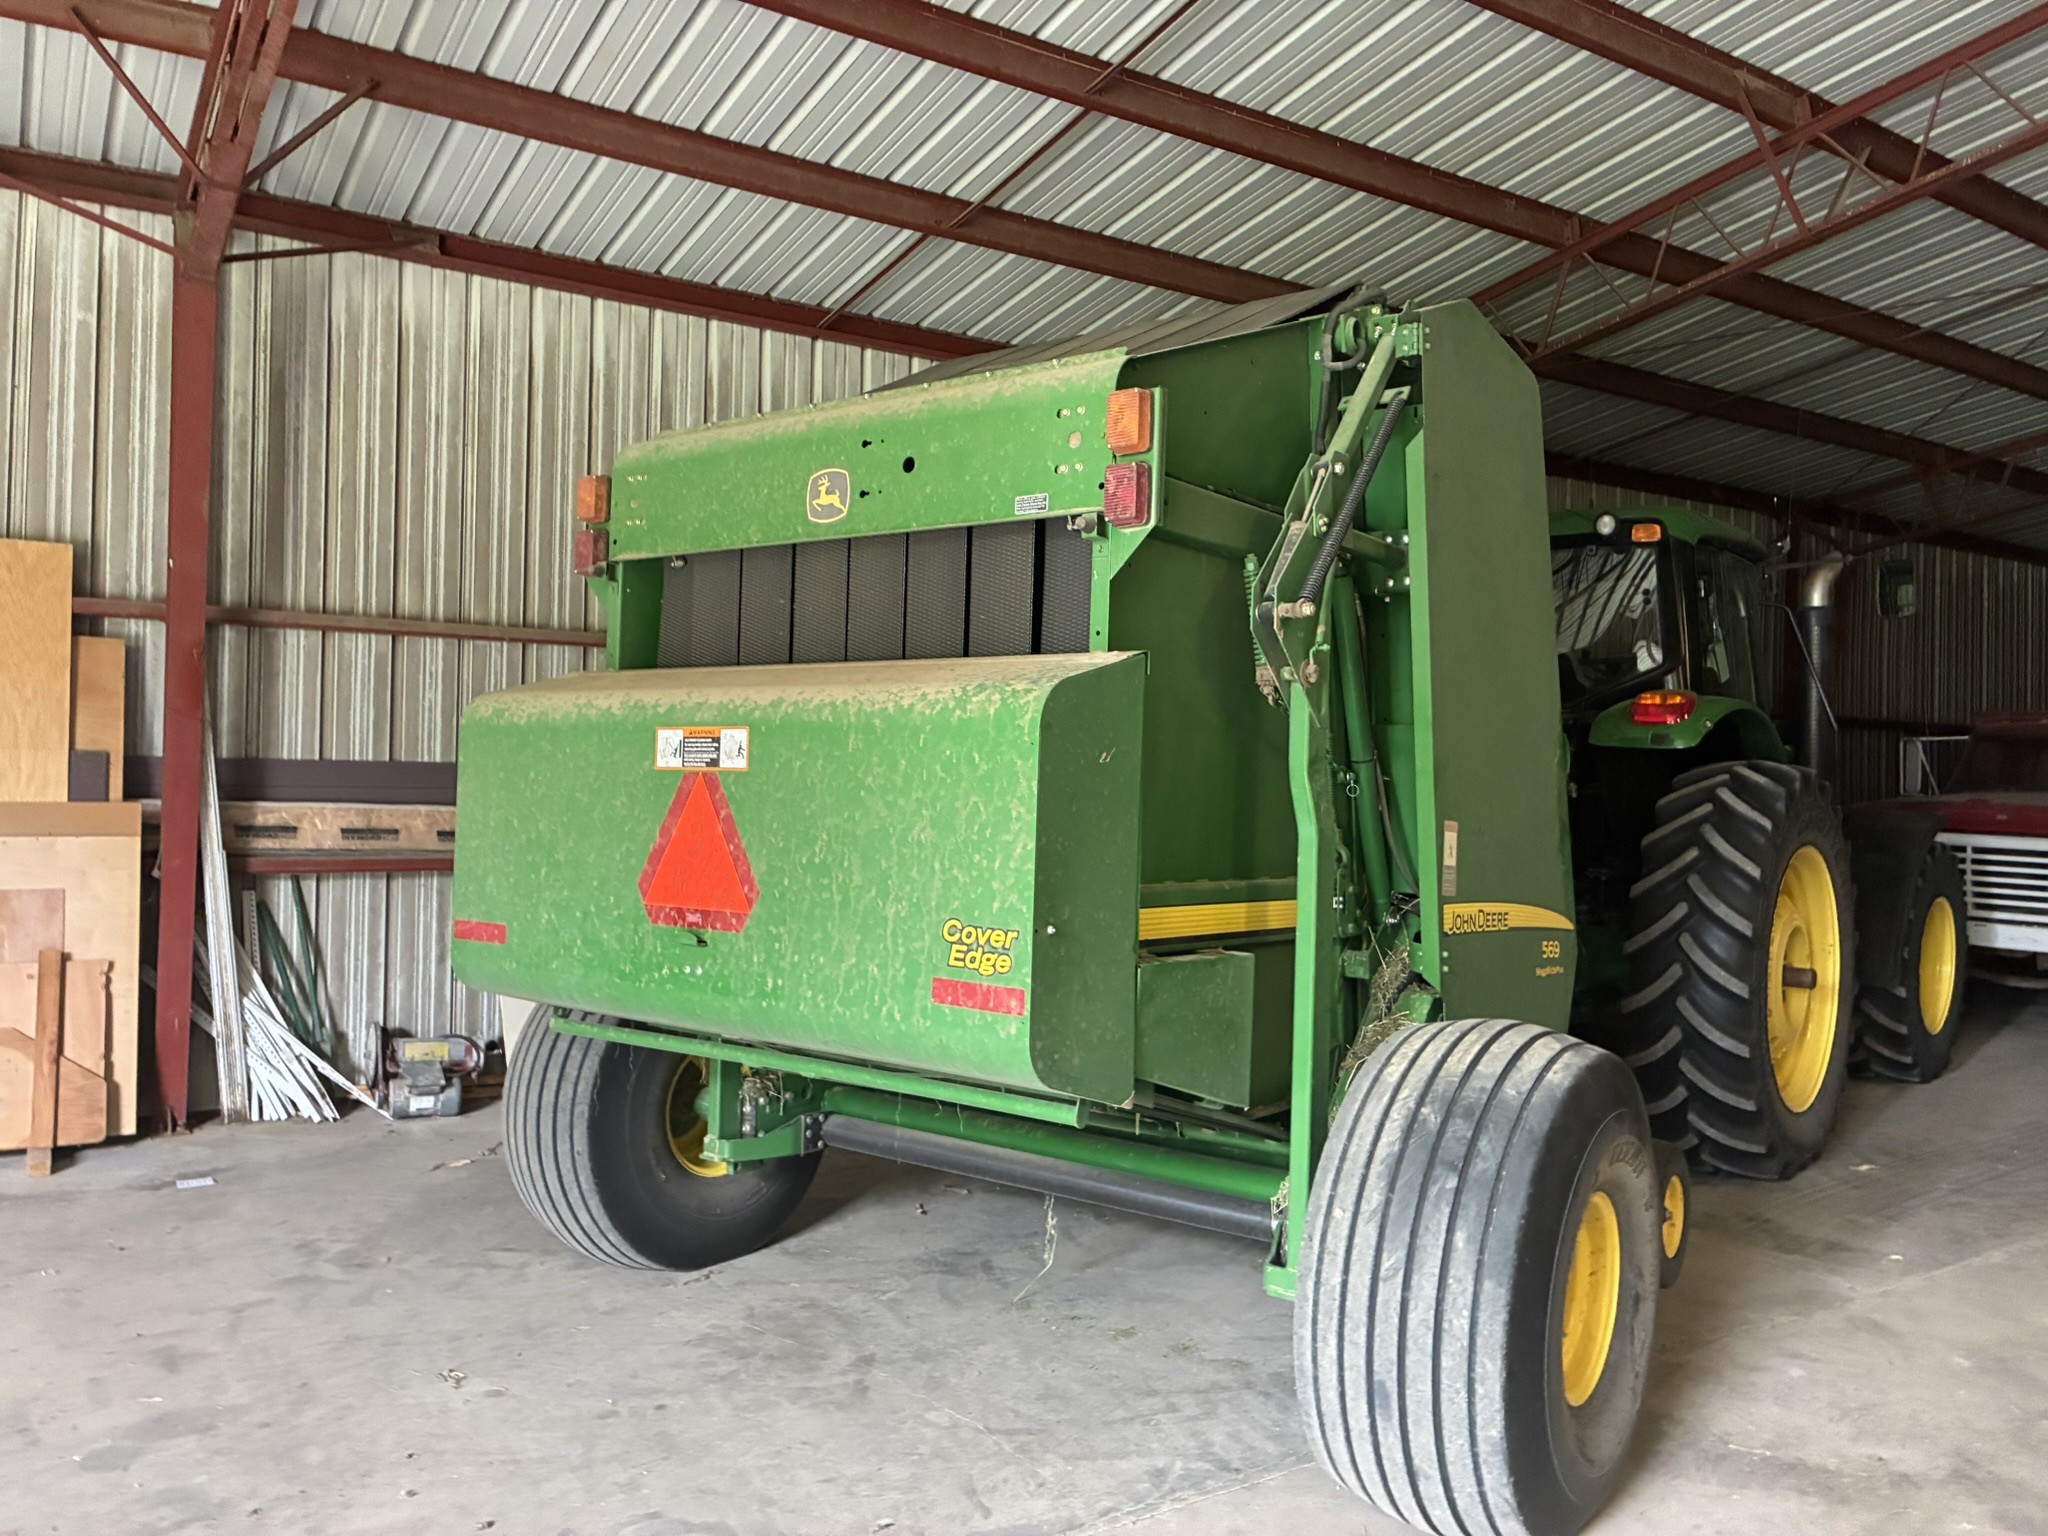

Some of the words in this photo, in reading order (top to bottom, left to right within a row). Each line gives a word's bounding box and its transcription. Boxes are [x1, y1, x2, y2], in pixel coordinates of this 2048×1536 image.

[942, 918, 1019, 949] Cover
[1448, 910, 1477, 933] JOHN
[1478, 908, 1509, 929] DEERE
[947, 943, 1012, 976] Edge
[1541, 940, 1561, 959] 569
